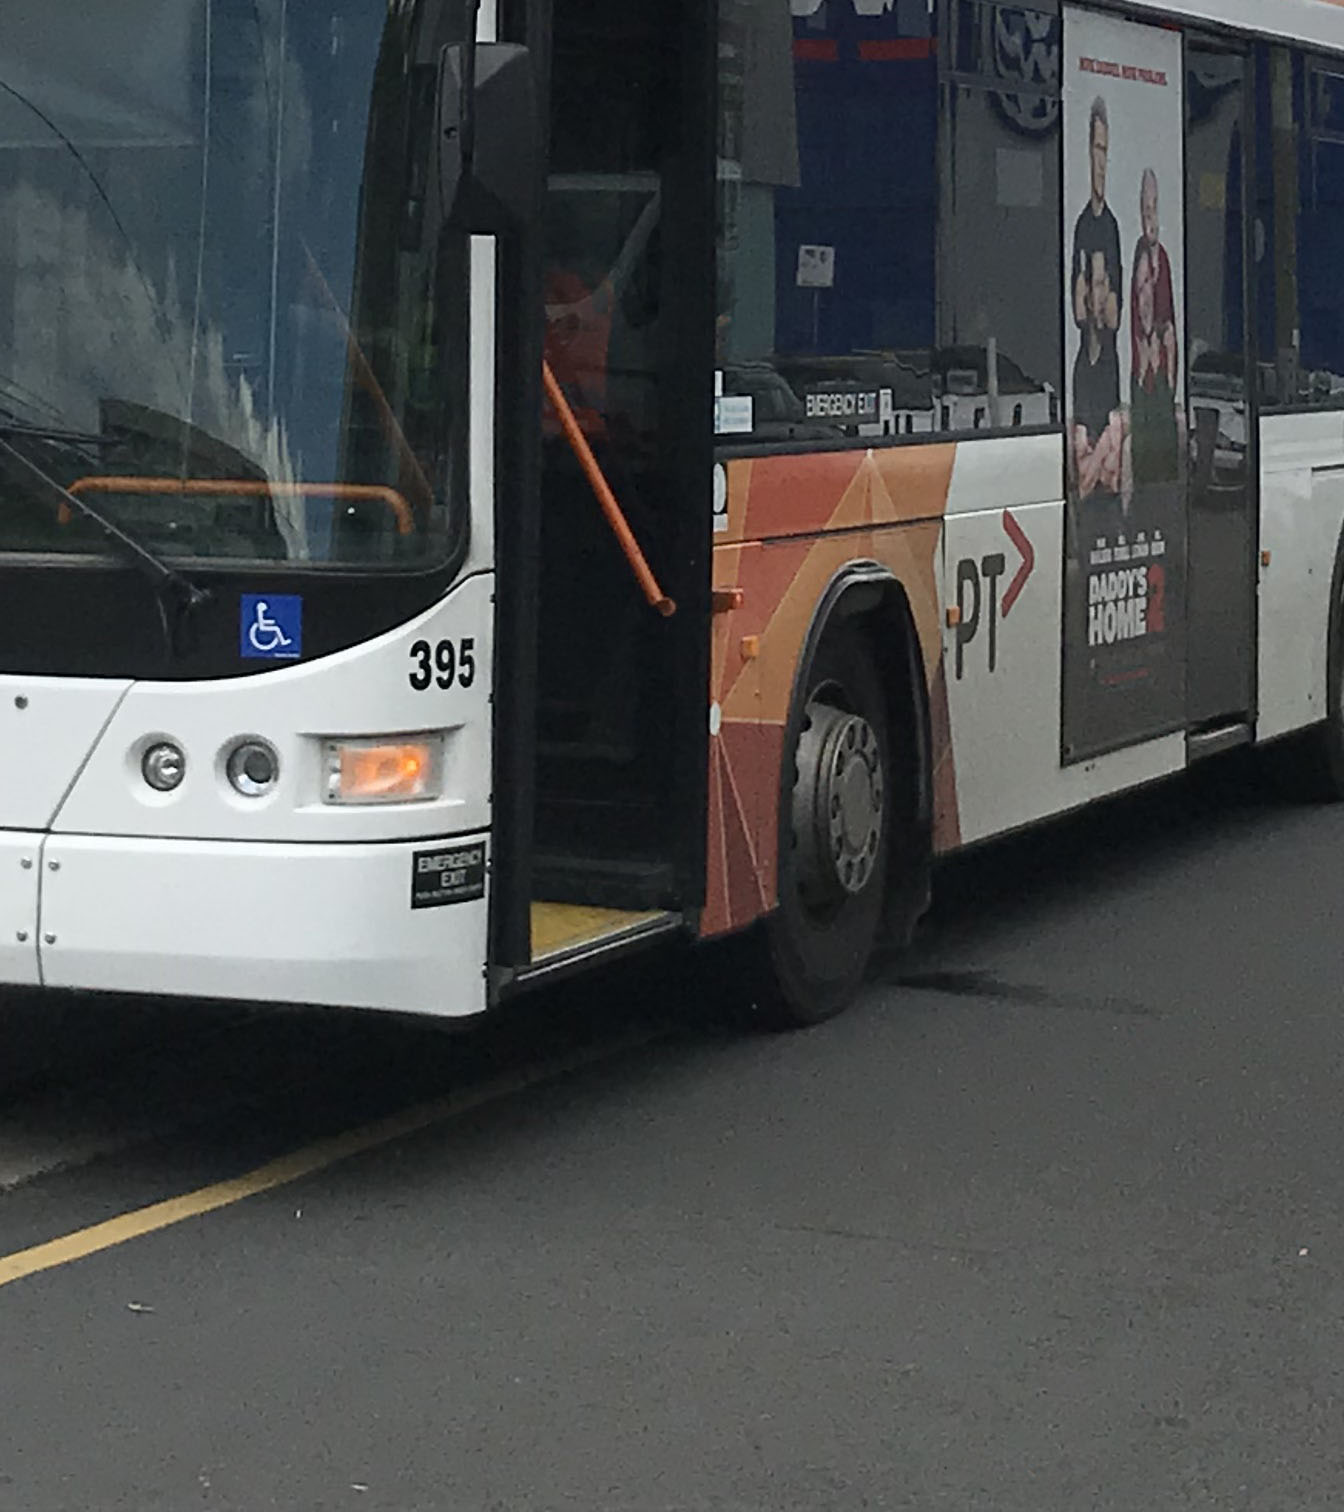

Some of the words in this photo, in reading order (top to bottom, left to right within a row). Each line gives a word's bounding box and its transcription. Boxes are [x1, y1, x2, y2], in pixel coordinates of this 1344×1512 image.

[955, 552, 1006, 680] PT
[1088, 565, 1148, 606] DADDY'S
[1088, 595, 1147, 647] HOME
[1147, 563, 1167, 633] 2
[408, 637, 475, 691] 395
